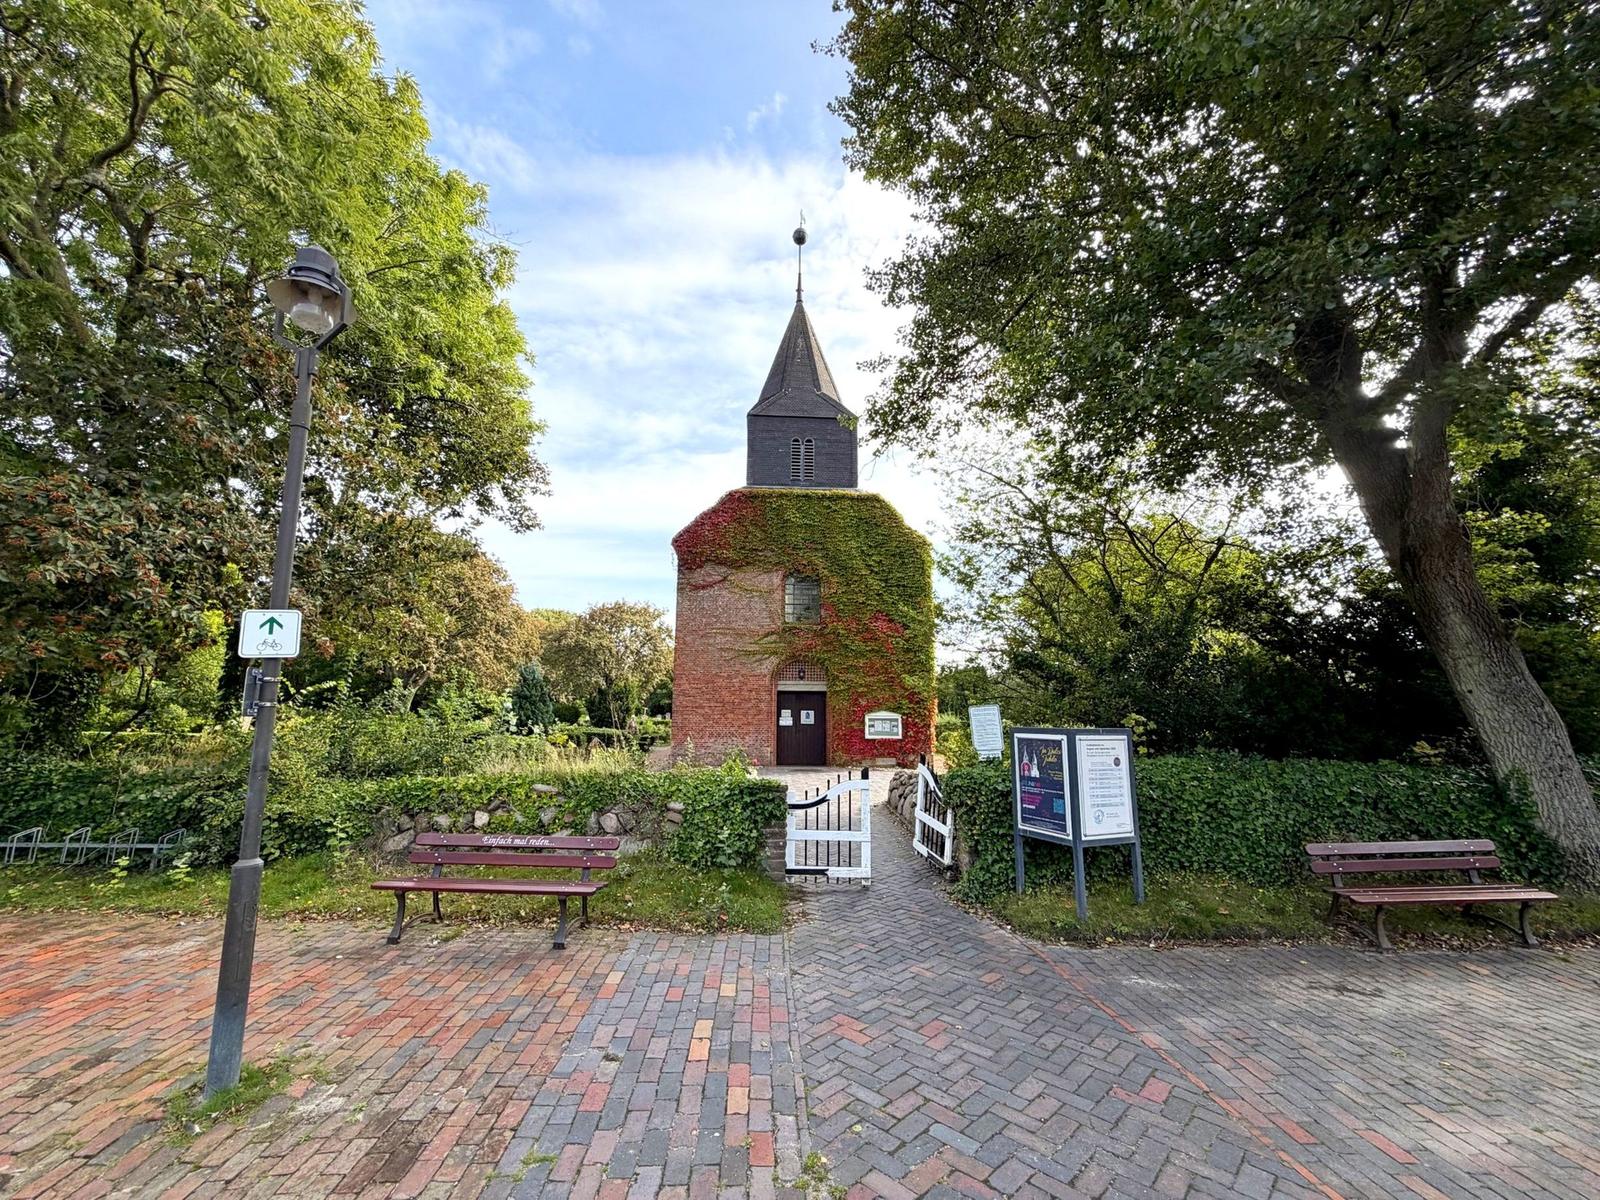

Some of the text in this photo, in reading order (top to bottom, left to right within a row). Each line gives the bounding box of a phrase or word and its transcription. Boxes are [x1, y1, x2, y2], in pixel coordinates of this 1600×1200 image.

[482, 836, 555, 846] Einfach mal reden...
